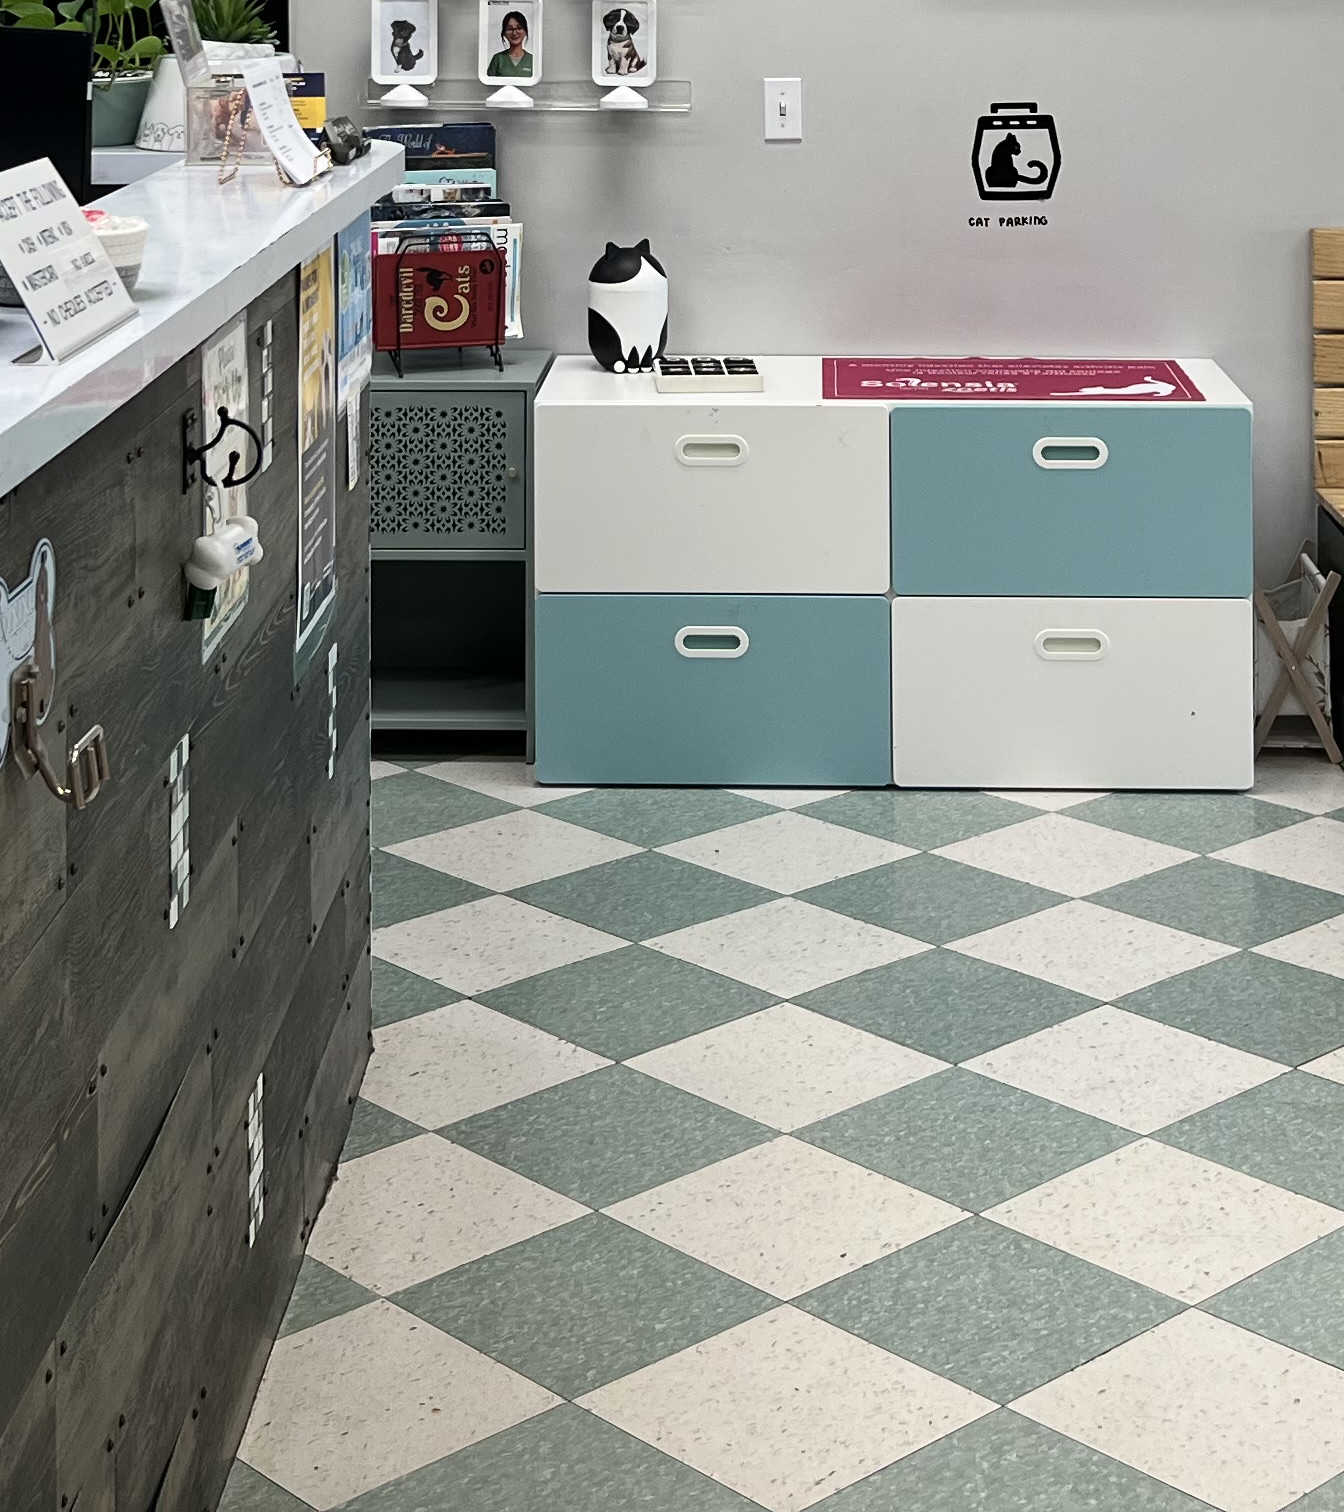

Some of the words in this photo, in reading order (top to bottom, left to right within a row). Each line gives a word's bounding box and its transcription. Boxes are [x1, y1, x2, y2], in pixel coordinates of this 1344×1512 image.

[423, 132, 434, 150] of
[968, 217, 990, 227] CAT
[399, 266, 414, 334] Daredevil
[422, 264, 472, 333] Cats
[860, 377, 1017, 389] Solensia
